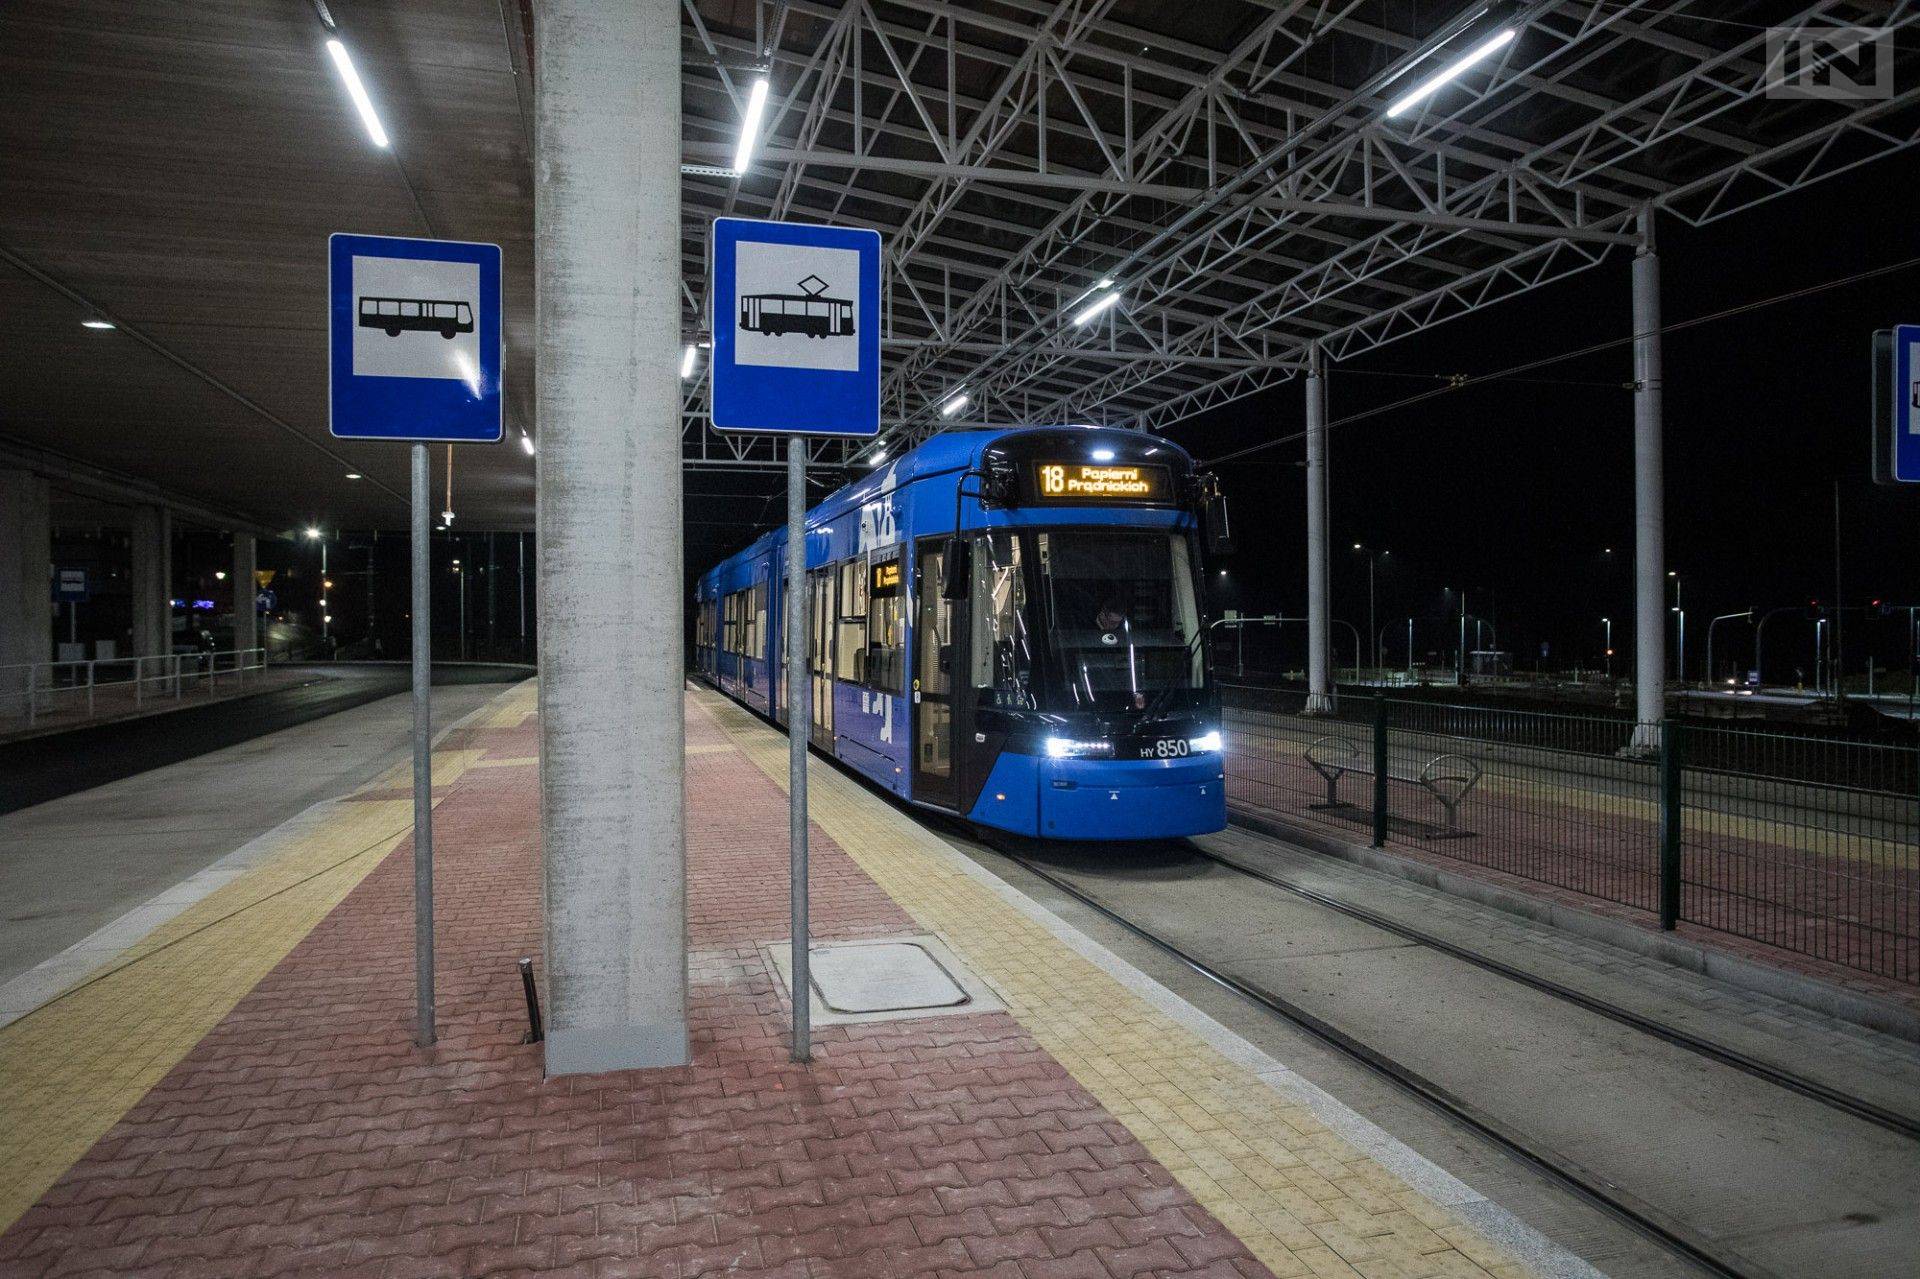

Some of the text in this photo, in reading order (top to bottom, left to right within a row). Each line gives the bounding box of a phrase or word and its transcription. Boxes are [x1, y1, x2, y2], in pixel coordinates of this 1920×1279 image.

[1042, 465, 1064, 493] 18
[1140, 739, 1188, 758] HY 850
